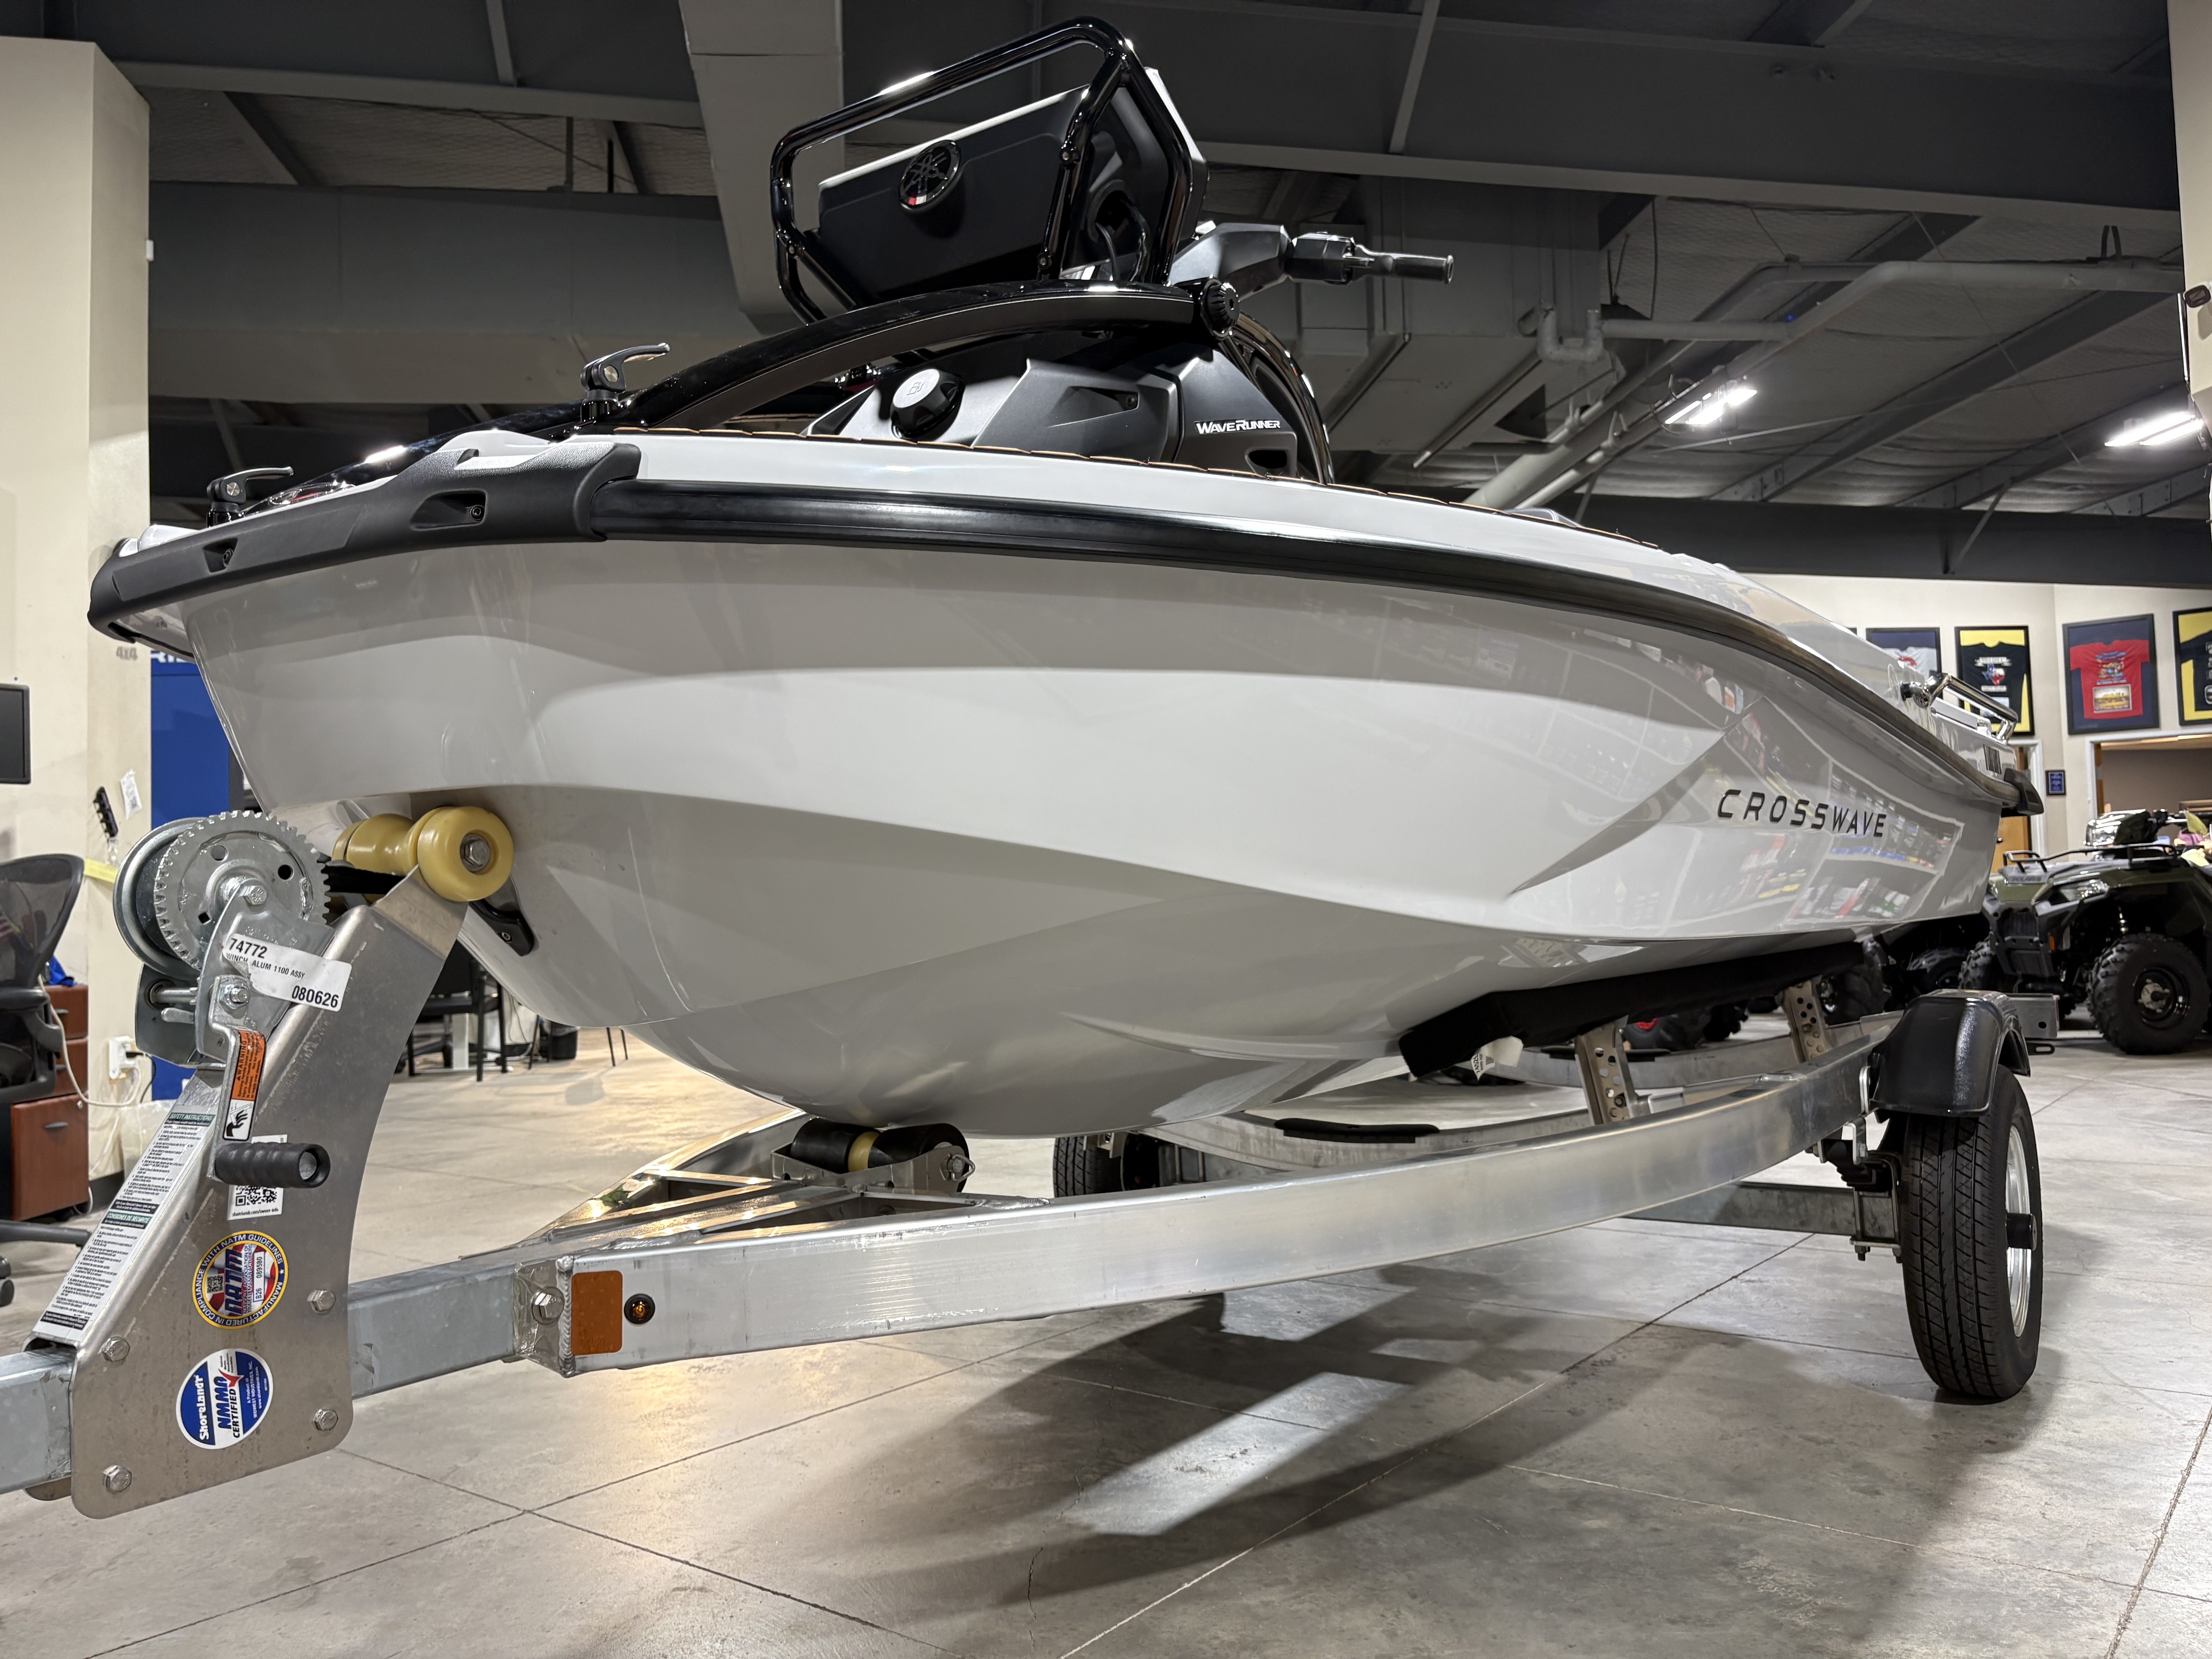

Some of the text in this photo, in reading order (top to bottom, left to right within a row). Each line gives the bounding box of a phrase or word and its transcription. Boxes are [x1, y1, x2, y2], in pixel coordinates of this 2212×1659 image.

[1717, 789, 1887, 837] CROSSWAVE
[229, 938, 267, 958] 74772
[252, 960, 271, 970] ALUM
[274, 965, 289, 975] 1100
[290, 970, 305, 979] ASSY
[292, 986, 339, 1008] 080626
[238, 1041, 247, 1075] WARNING
[221, 1234, 246, 1248] NATM
[248, 1234, 283, 1265] GUIDELINES
[202, 1246, 220, 1266] WITH
[195, 1267, 216, 1321] COMPLIANCE
[226, 1281, 283, 1326] MANUFACTURED
[216, 1316, 224, 1325] IN
[229, 1389, 240, 1438] CERTIFIED
